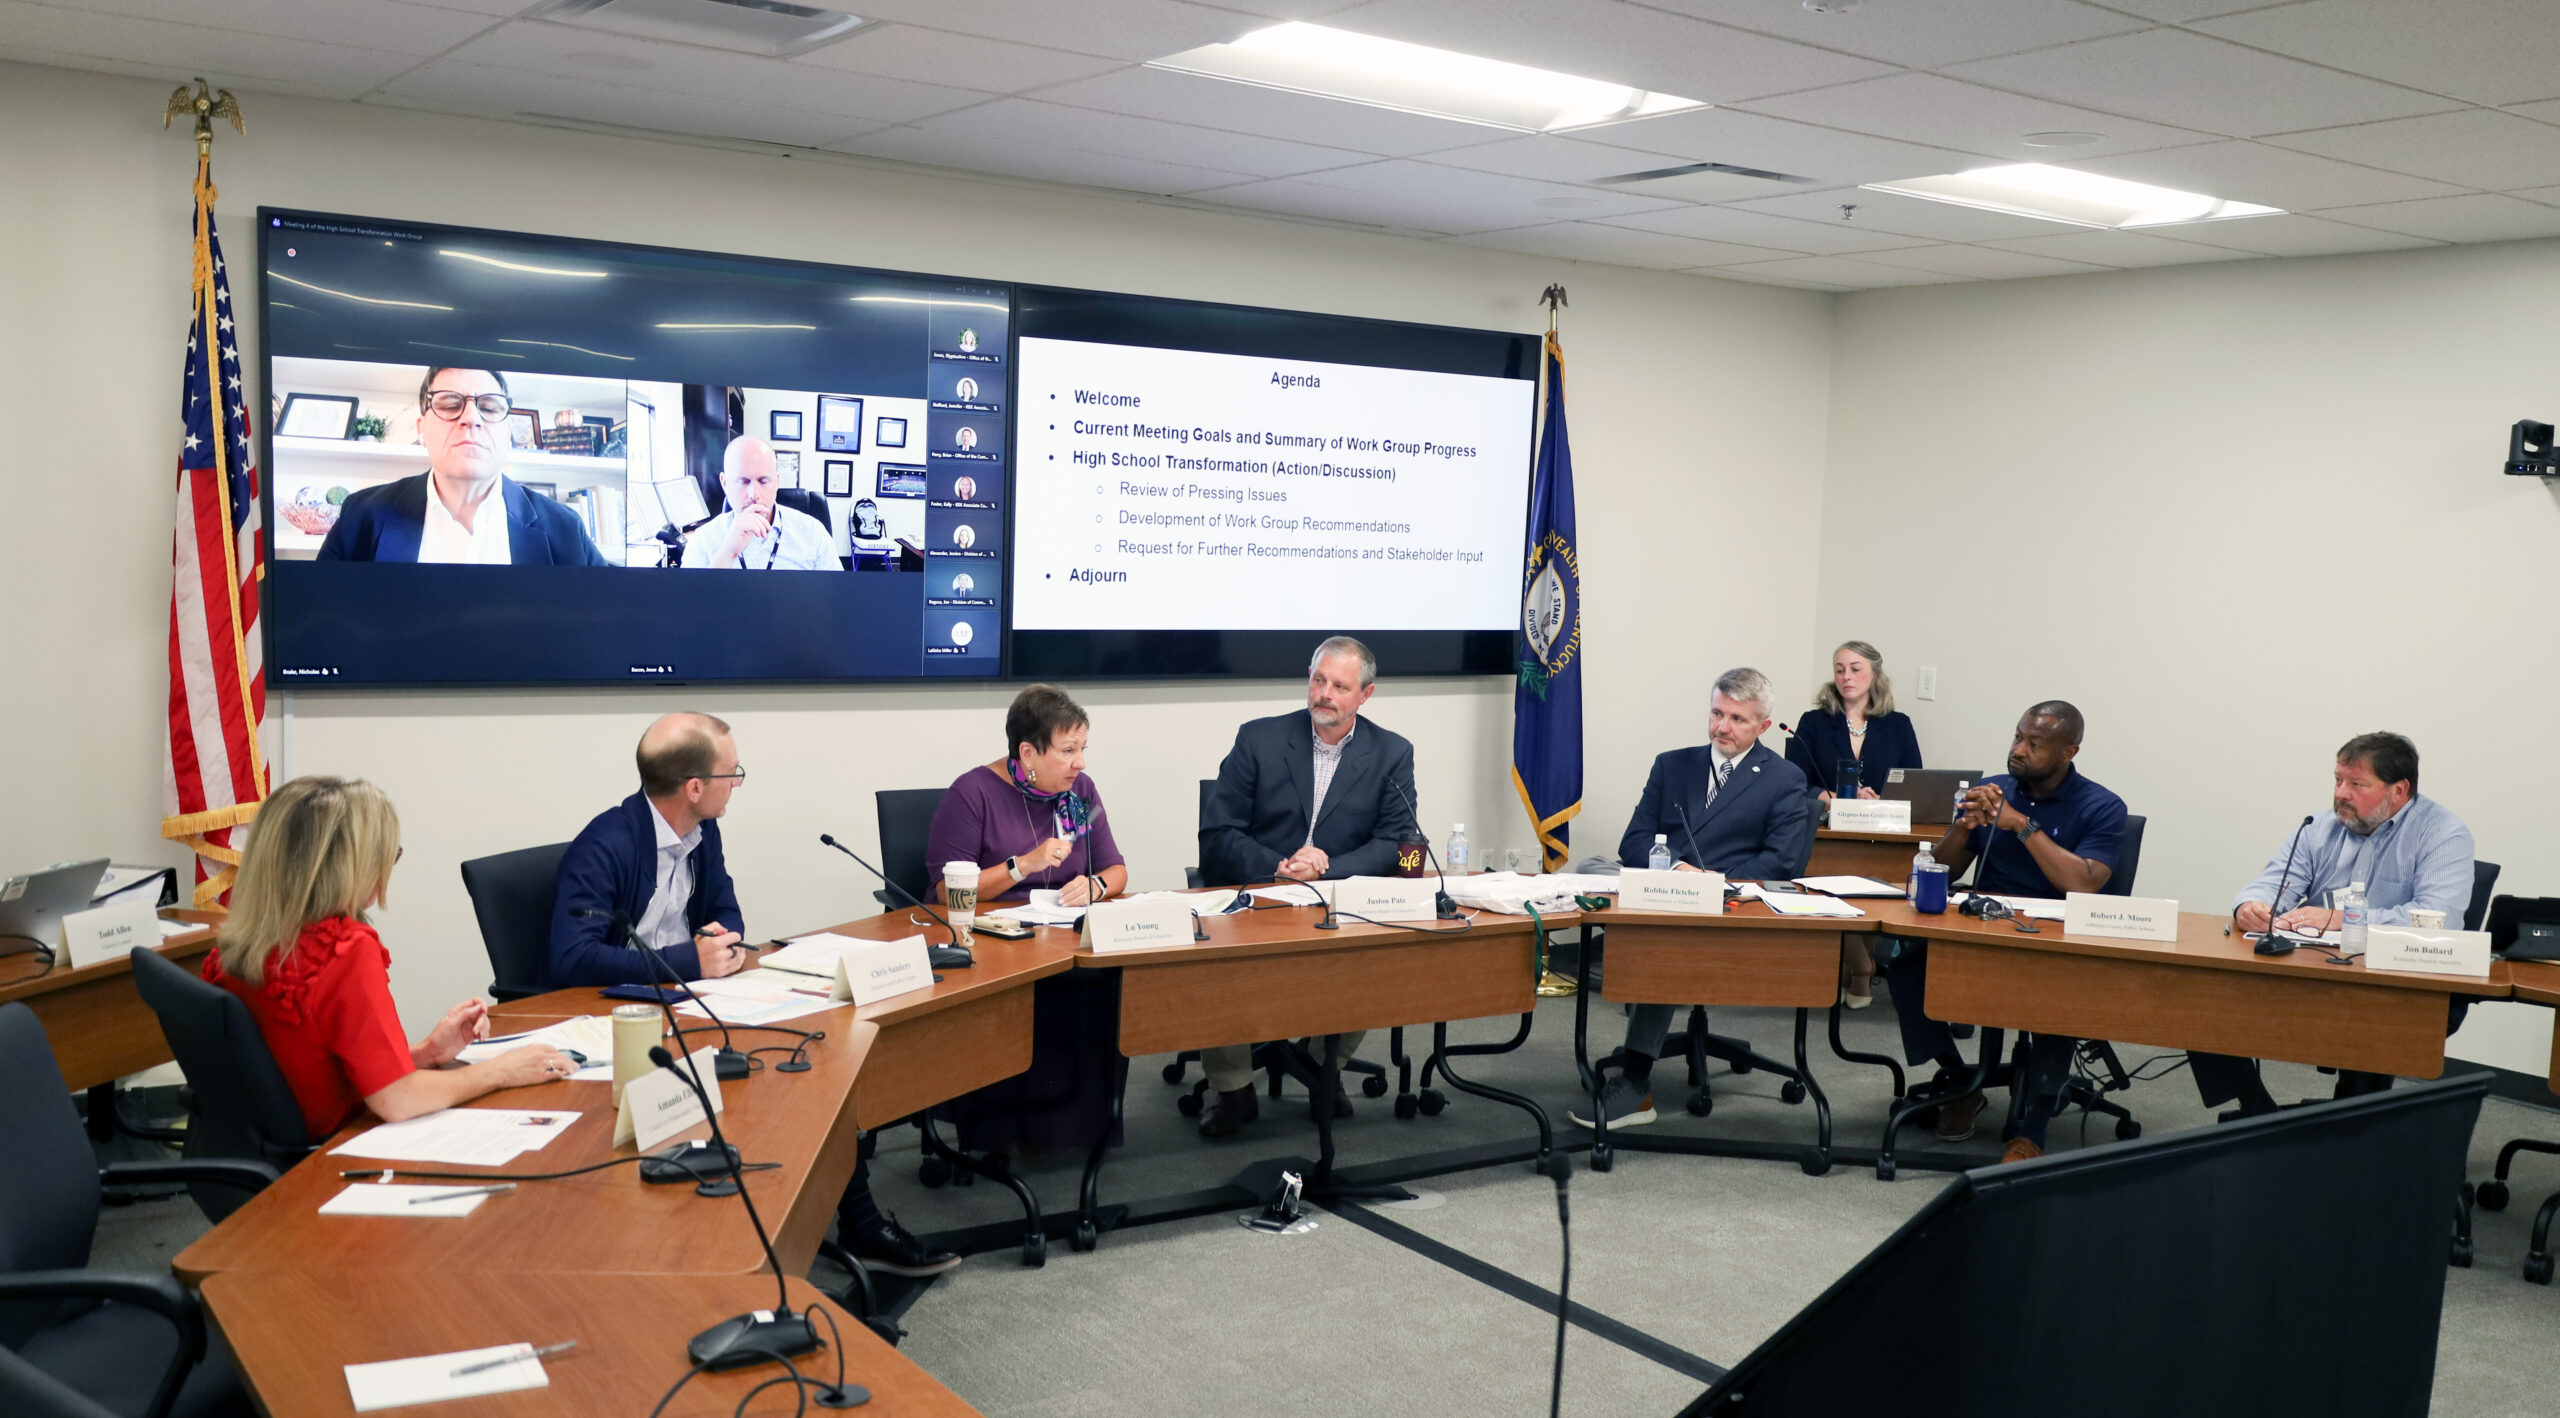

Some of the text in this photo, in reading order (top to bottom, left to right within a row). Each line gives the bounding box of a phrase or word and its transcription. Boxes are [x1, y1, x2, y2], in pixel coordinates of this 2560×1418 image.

[1271, 371, 1321, 389] Agenda
[1074, 390, 1141, 408] Welcome
[1073, 420, 1477, 460] Current Meeting Goals and Summary of Work Group Progress
[1072, 450, 1397, 483] High School Transformation (Action/Discussion)
[1120, 482, 1287, 504] Review of Pressing Issues
[1119, 510, 1411, 534] Development of Work Group Recommendations
[1118, 540, 1484, 565] Request for Further Recommendations and Stakeholder Input
[1069, 567, 1127, 586] Adjourn
[1551, 598, 1561, 625] STAND
[1528, 609, 1540, 640] DIVIDED
[1644, 887, 1700, 896] Robbie Fletcher
[2090, 911, 2117, 920] Robert
[2127, 914, 2153, 923] Moore
[98, 924, 132, 939] Todd Allen
[1125, 922, 1159, 932] Lu Young
[2404, 945, 2453, 956] Jon Ballard
[871, 961, 911, 979] Chris Sanders
[657, 1093, 682, 1112] Amanda
